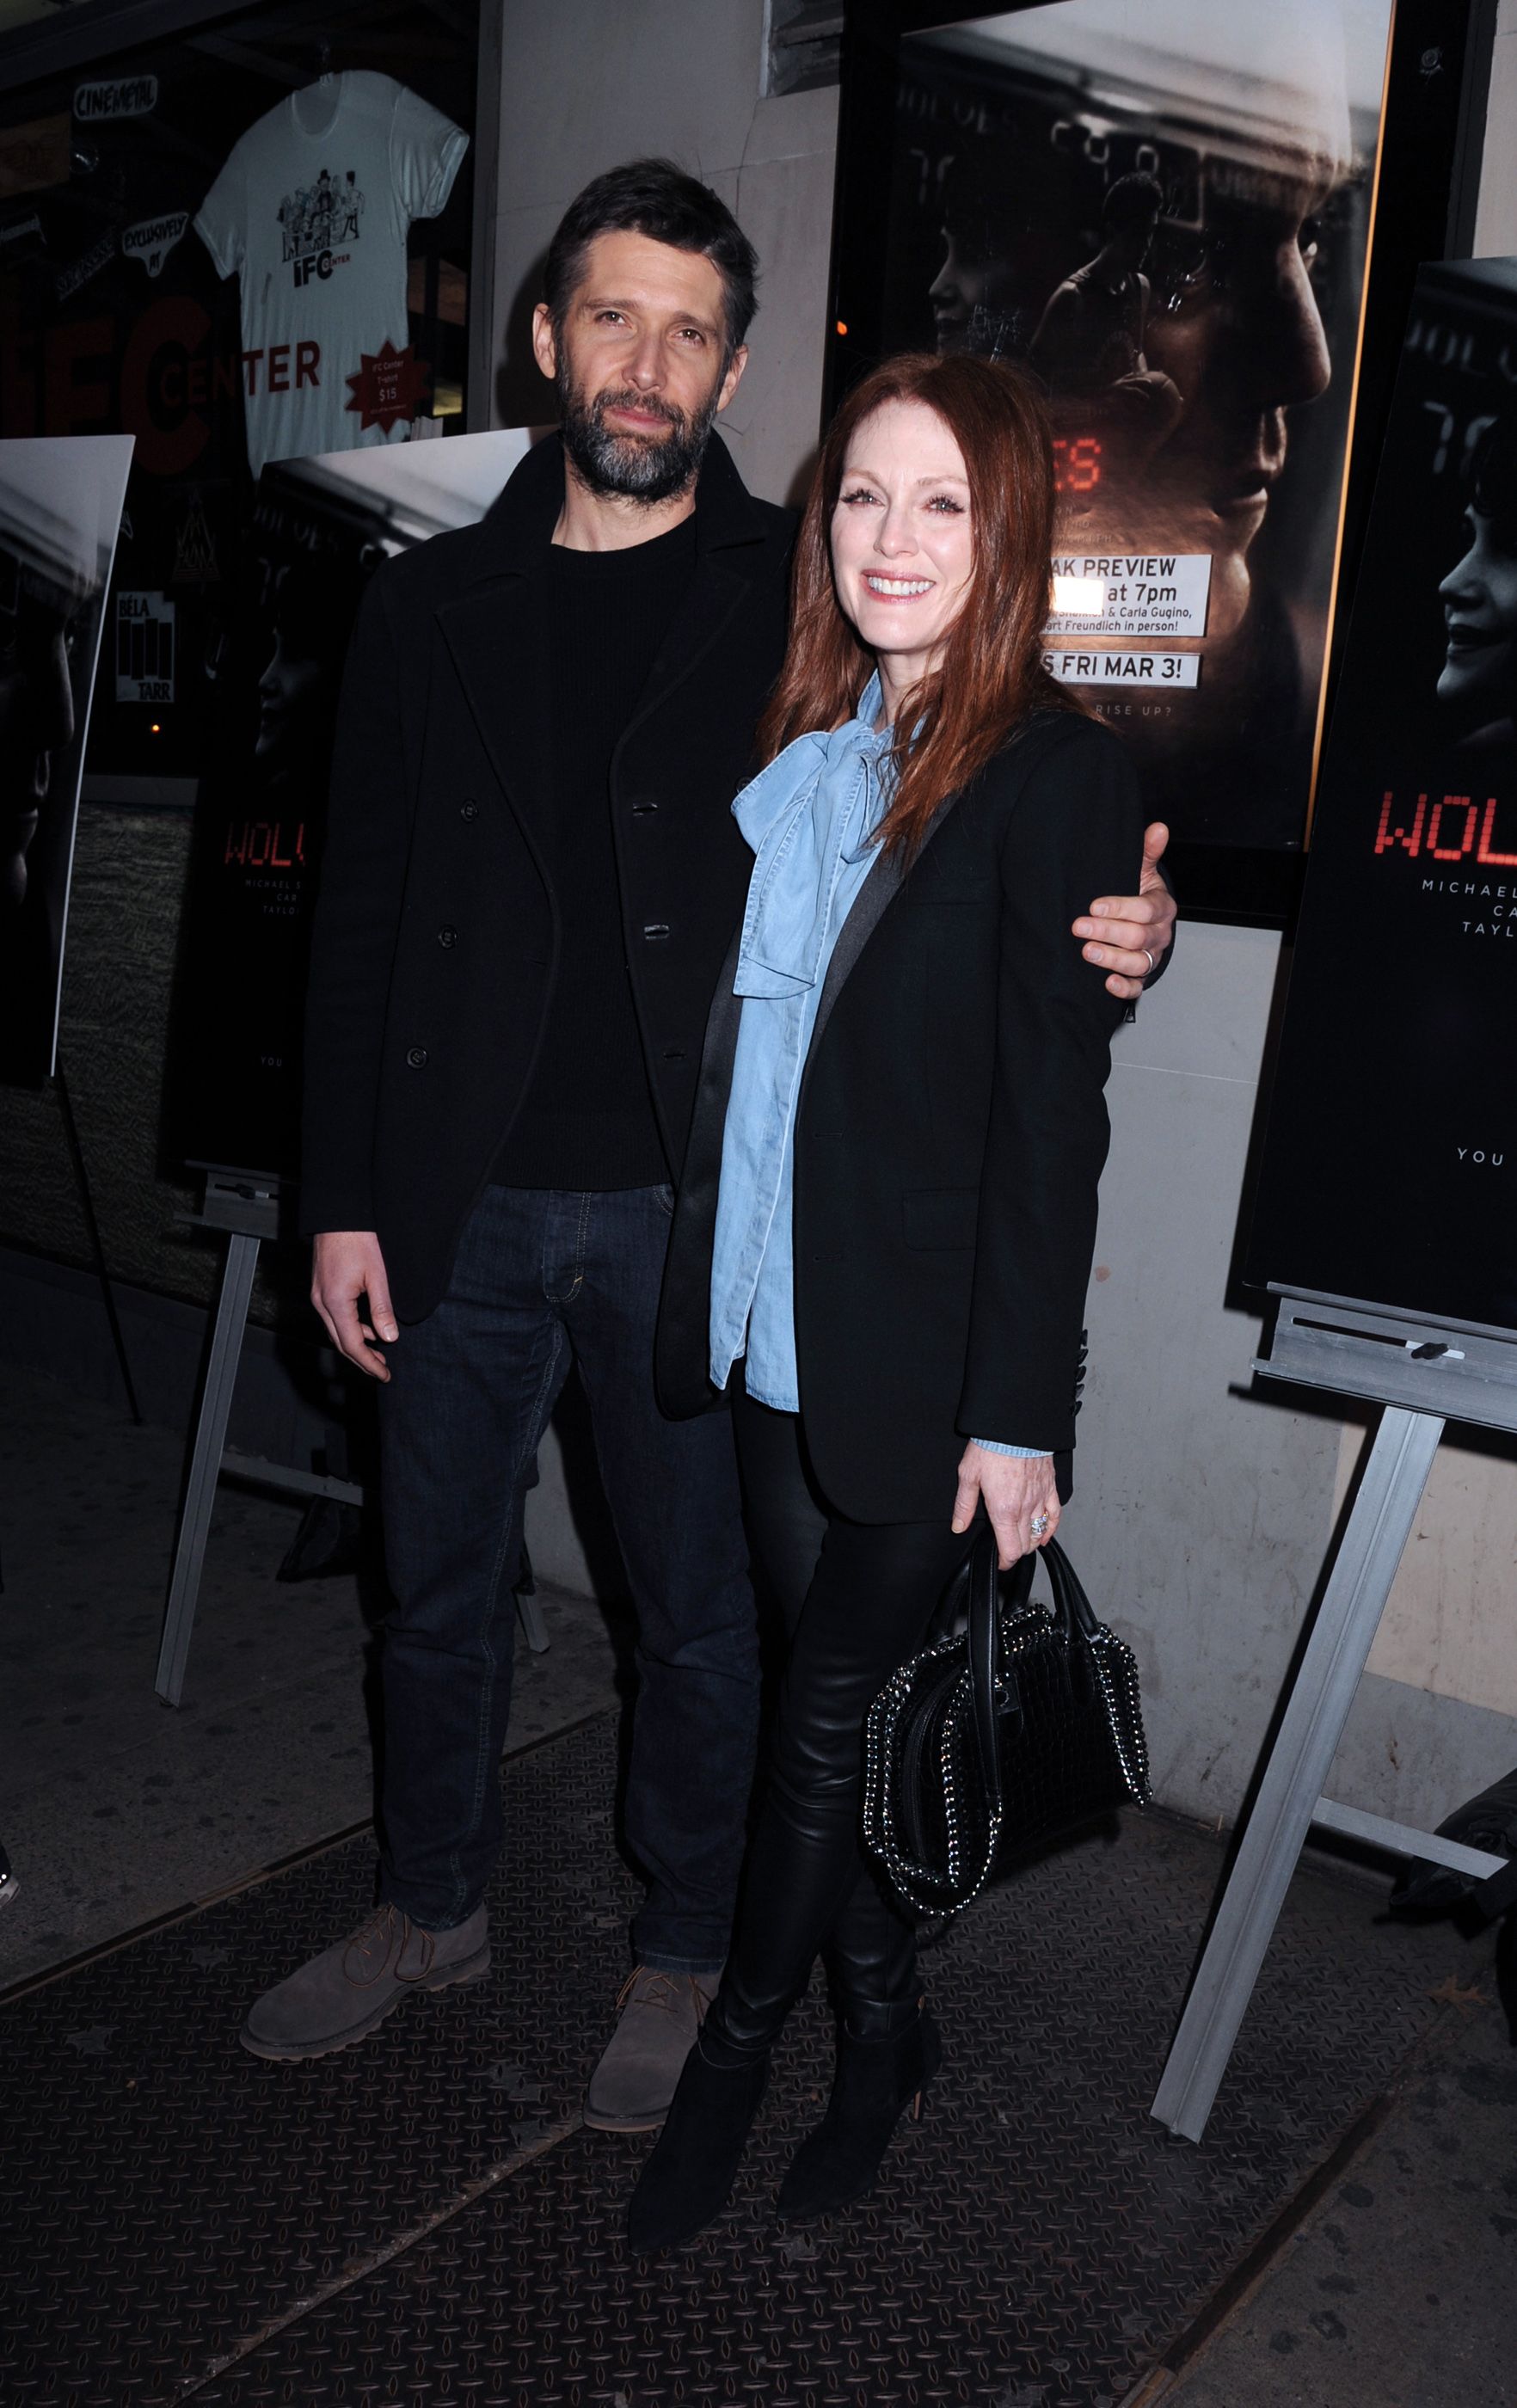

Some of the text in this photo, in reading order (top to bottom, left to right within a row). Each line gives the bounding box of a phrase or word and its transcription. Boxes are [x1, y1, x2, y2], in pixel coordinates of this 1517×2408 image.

[125, 215, 187, 249] EXCLUSIVELY
[150, 251, 162, 270] AT
[294, 249, 334, 287] IFC
[384, 359, 405, 371] Center
[0, 294, 213, 476] IFC
[161, 340, 321, 411] CENTER
[379, 387, 397, 402] $15
[1083, 558, 1176, 577] PREVIEW
[1108, 583, 1177, 605] at 7pm
[119, 595, 150, 617] BÉLA
[1108, 606, 1116, 617] &
[1120, 606, 1147, 617] Carla
[1151, 606, 1192, 619] Gugino,
[1044, 620, 1178, 633] art Freundlich in person!
[1062, 655, 1097, 676] FRI
[1104, 657, 1154, 678] MAR
[1161, 658, 1182, 679] 3!
[138, 681, 171, 701] TARR
[1096, 704, 1172, 716] RISE UP?
[1373, 790, 1517, 866] WOL
[244, 878, 290, 889] MICHAEL
[1421, 879, 1517, 899] MICHAEL
[1463, 921, 1514, 937] TAYL
[261, 1054, 282, 1067] YOU
[1457, 1146, 1503, 1166] YOU
